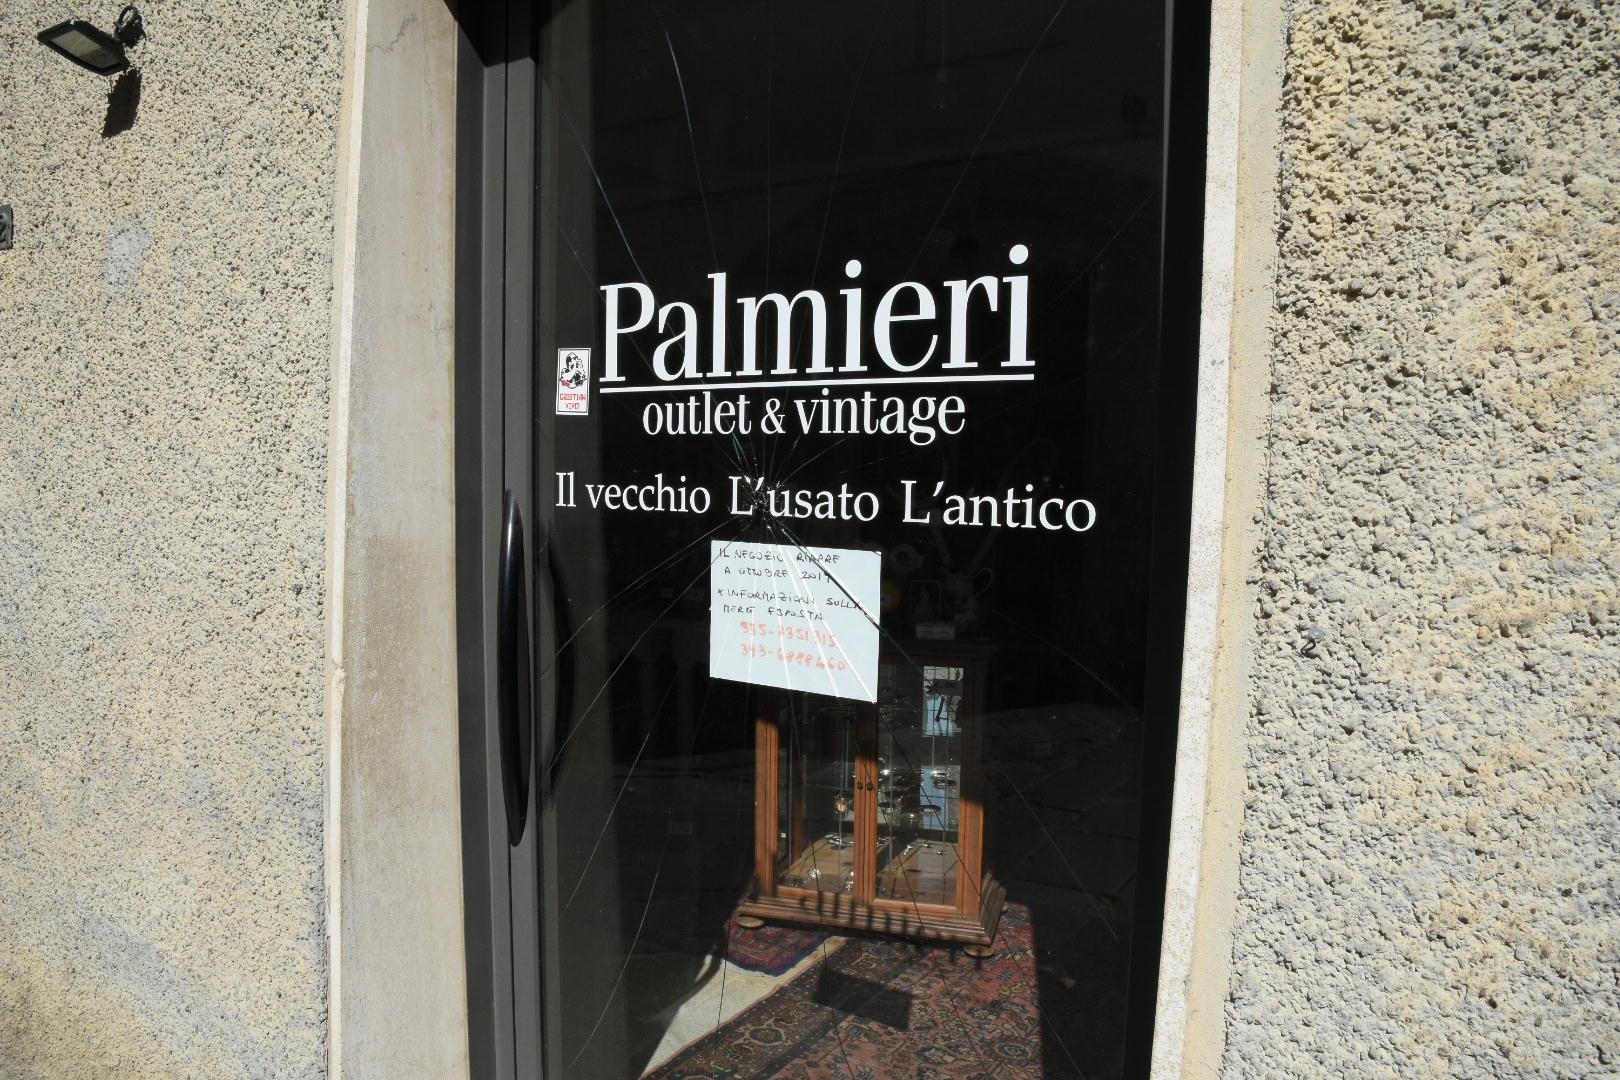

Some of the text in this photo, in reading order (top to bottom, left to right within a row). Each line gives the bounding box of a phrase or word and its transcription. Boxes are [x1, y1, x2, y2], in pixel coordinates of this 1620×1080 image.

[599, 244, 1036, 383] Palmieri
[642, 387, 966, 446] outlet & vintage
[555, 471, 1097, 533] Il vecchio L'usato L'antico
[719, 547, 731, 559] IL
[724, 566, 732, 575] A
